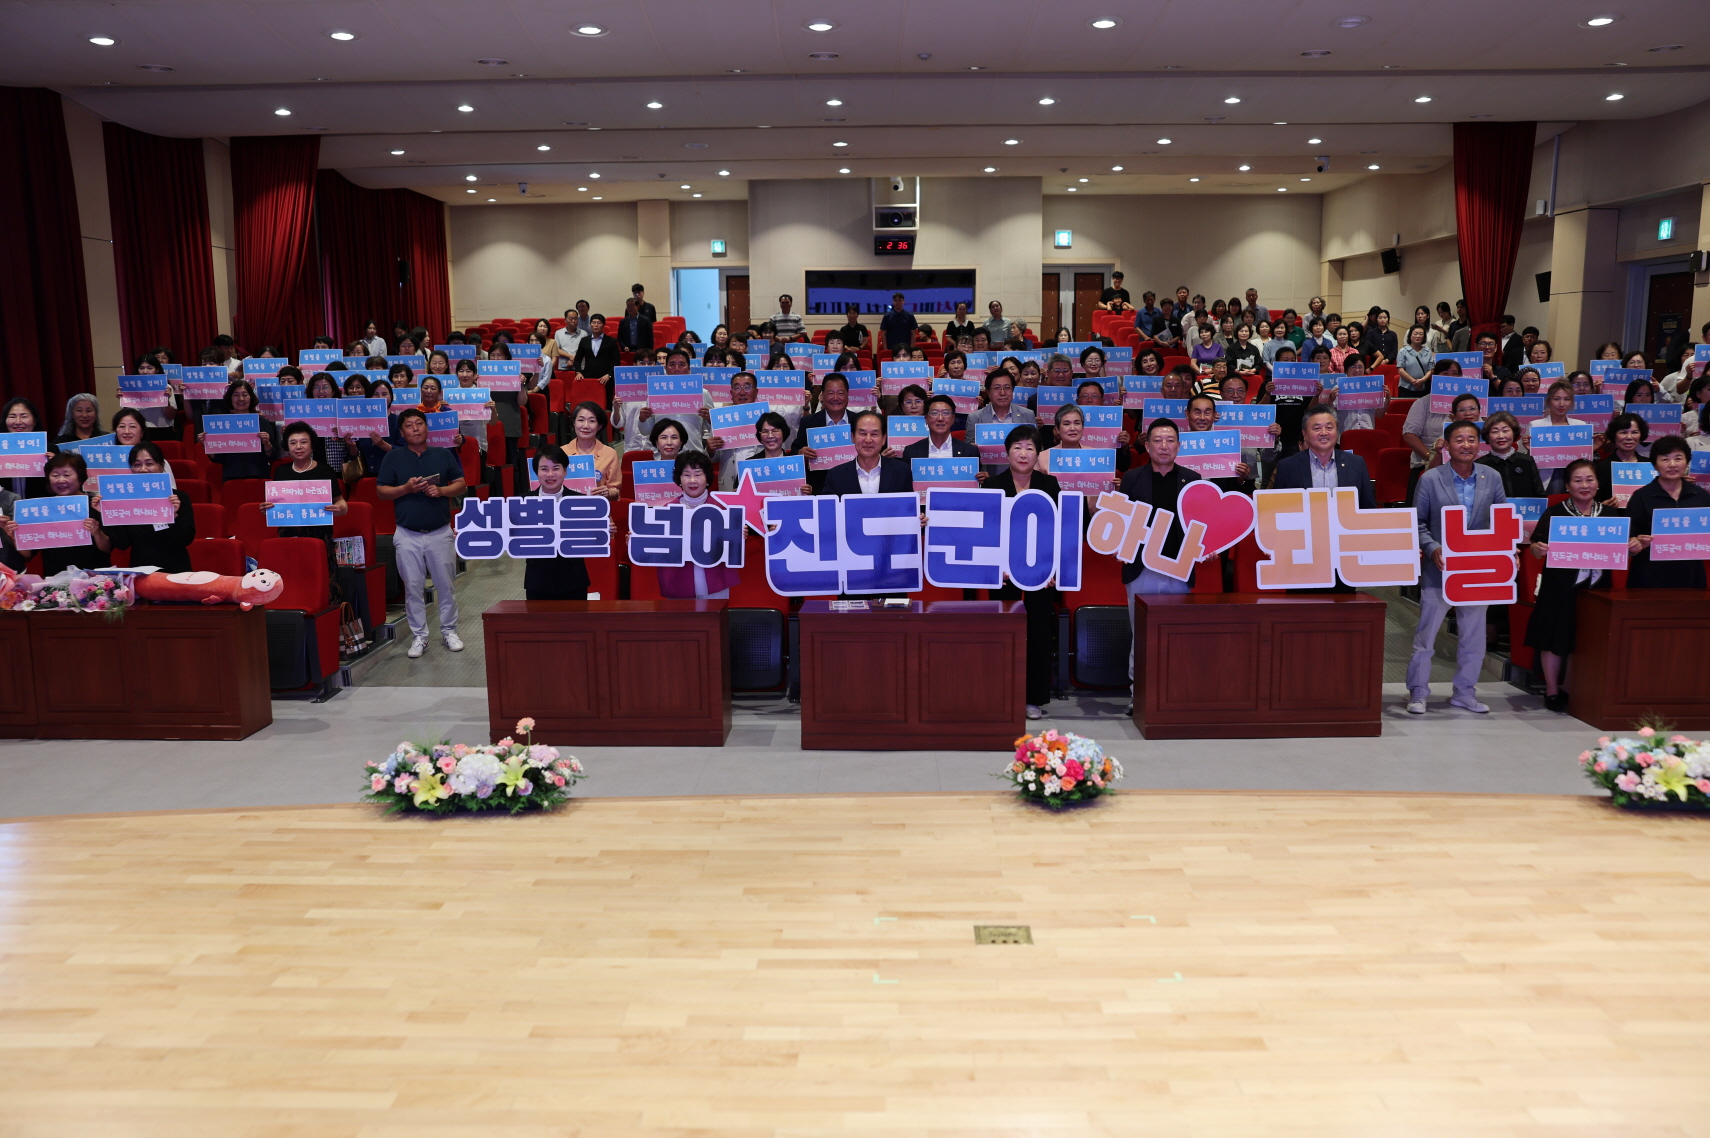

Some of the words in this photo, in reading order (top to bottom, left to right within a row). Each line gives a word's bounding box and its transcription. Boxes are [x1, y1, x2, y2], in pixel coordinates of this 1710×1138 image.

[303, 353, 320, 361] 성별을
[970, 357, 984, 365] 넘어!
[1464, 356, 1480, 364] 넘어!
[248, 362, 266, 370] 성별을
[481, 364, 499, 372] 성별을
[502, 364, 517, 372] 넘어!
[886, 366, 905, 375] 성별을
[909, 366, 925, 374] 넘어!
[1278, 366, 1296, 375] 성별을
[1301, 367, 1316, 375] 넘어!
[1546, 365, 1561, 374] 넘어!
[186, 371, 205, 379] 성별을
[208, 370, 224, 378] 넘어!
[620, 371, 639, 380] 성별을
[759, 375, 780, 384] 성별을
[784, 375, 800, 384] 넘어!
[855, 375, 872, 384] 넘어!
[1608, 372, 1628, 381] 성별을
[123, 380, 142, 388] 성별을
[147, 379, 163, 387] 넘어!
[653, 380, 675, 390] 성별을
[680, 379, 698, 389] 넘어!
[937, 384, 956, 392] 성별을
[960, 385, 976, 393] 넘어!
[1128, 380, 1147, 388] 성별을
[1343, 381, 1361, 390] 성별을
[1365, 379, 1381, 388] 넘어!
[1437, 381, 1459, 392] 성별을
[1465, 383, 1483, 393] 넘어!
[262, 391, 281, 399] 성별을
[286, 390, 302, 398] 넘어!
[401, 392, 417, 400] 넘어!
[448, 392, 466, 400] 성별을
[471, 391, 487, 399] 넘어!
[795, 393, 804, 402] 날!
[1044, 391, 1065, 401] 성별을
[289, 404, 311, 413] 성별을
[316, 404, 335, 413] 넘어!
[342, 404, 362, 413] 성별을
[366, 404, 382, 412] 넘어!
[651, 401, 671, 410] 진도군이
[671, 401, 691, 409] 하나되는
[693, 400, 702, 410] 날!
[1149, 404, 1171, 413] 성별을
[1493, 402, 1515, 412] 성별을
[1521, 402, 1539, 412] 넘어!
[1591, 399, 1610, 409] 넘어!
[717, 410, 740, 422] 성별을
[1099, 411, 1118, 422] 넘어!
[1220, 410, 1244, 421] 성별을
[1251, 411, 1271, 421] 넘어!
[1659, 409, 1677, 419] 넘어!
[209, 420, 230, 429] 성별을
[236, 419, 254, 428] 넘어!
[438, 416, 455, 426] 넘어!
[894, 421, 917, 431] 성별을
[340, 425, 358, 433] 진도군이
[378, 424, 387, 433] 날!
[813, 433, 836, 444] 성별을
[982, 430, 1005, 440] 성별을
[1087, 434, 1108, 443] 하나되는
[1537, 432, 1561, 443] 성별을
[1568, 430, 1588, 441] 넘어!
[18, 438, 40, 448] 넘어!
[206, 440, 227, 448] 진도군이
[228, 439, 248, 447] 하나되는
[249, 439, 260, 448] 날!
[1181, 438, 1206, 450] 성별을
[1213, 436, 1235, 448] 넘어!
[87, 453, 112, 463] 성별을
[1056, 456, 1081, 467] 성별을
[1089, 455, 1110, 466] 넘어!
[1533, 453, 1555, 463] 진도군이
[1556, 452, 1579, 461] 하나되는
[568, 462, 589, 473] 넘어!
[778, 462, 799, 474] 넘어!
[919, 465, 944, 475] 성별을
[952, 464, 973, 475] 넘어!
[1202, 462, 1226, 471] 하나되는
[641, 468, 666, 478] 성별을
[1618, 469, 1643, 480] 성별을
[106, 482, 135, 494] 성별을
[142, 480, 165, 491] 넘어!
[1077, 480, 1100, 490] 하나되는
[637, 492, 662, 501] 진도군이
[21, 506, 49, 517] 성별을
[57, 503, 81, 514] 넘어!
[105, 508, 131, 519] 진도군이
[133, 507, 158, 516] 하나되는
[160, 506, 172, 518] 날!
[1519, 504, 1541, 515] 넘어!
[1661, 516, 1690, 528] 성별을
[18, 532, 45, 543] 진도군이
[47, 531, 73, 540] 하나되는
[76, 528, 90, 540] 날!
[1559, 525, 1588, 536] 성별을
[1597, 525, 1622, 536] 넘어!
[456, 496, 610, 559] 성별을
[629, 503, 745, 567] 넘어
[766, 487, 1083, 596] 진도군이
[1087, 491, 1204, 581] 하나
[1255, 487, 1420, 589] 되는
[1441, 503, 1523, 606] 날
[1654, 544, 1682, 554] 진도군이
[1551, 551, 1579, 562] 진도군이
[1581, 552, 1609, 563] 하나되는
[1612, 552, 1626, 565] 날!
